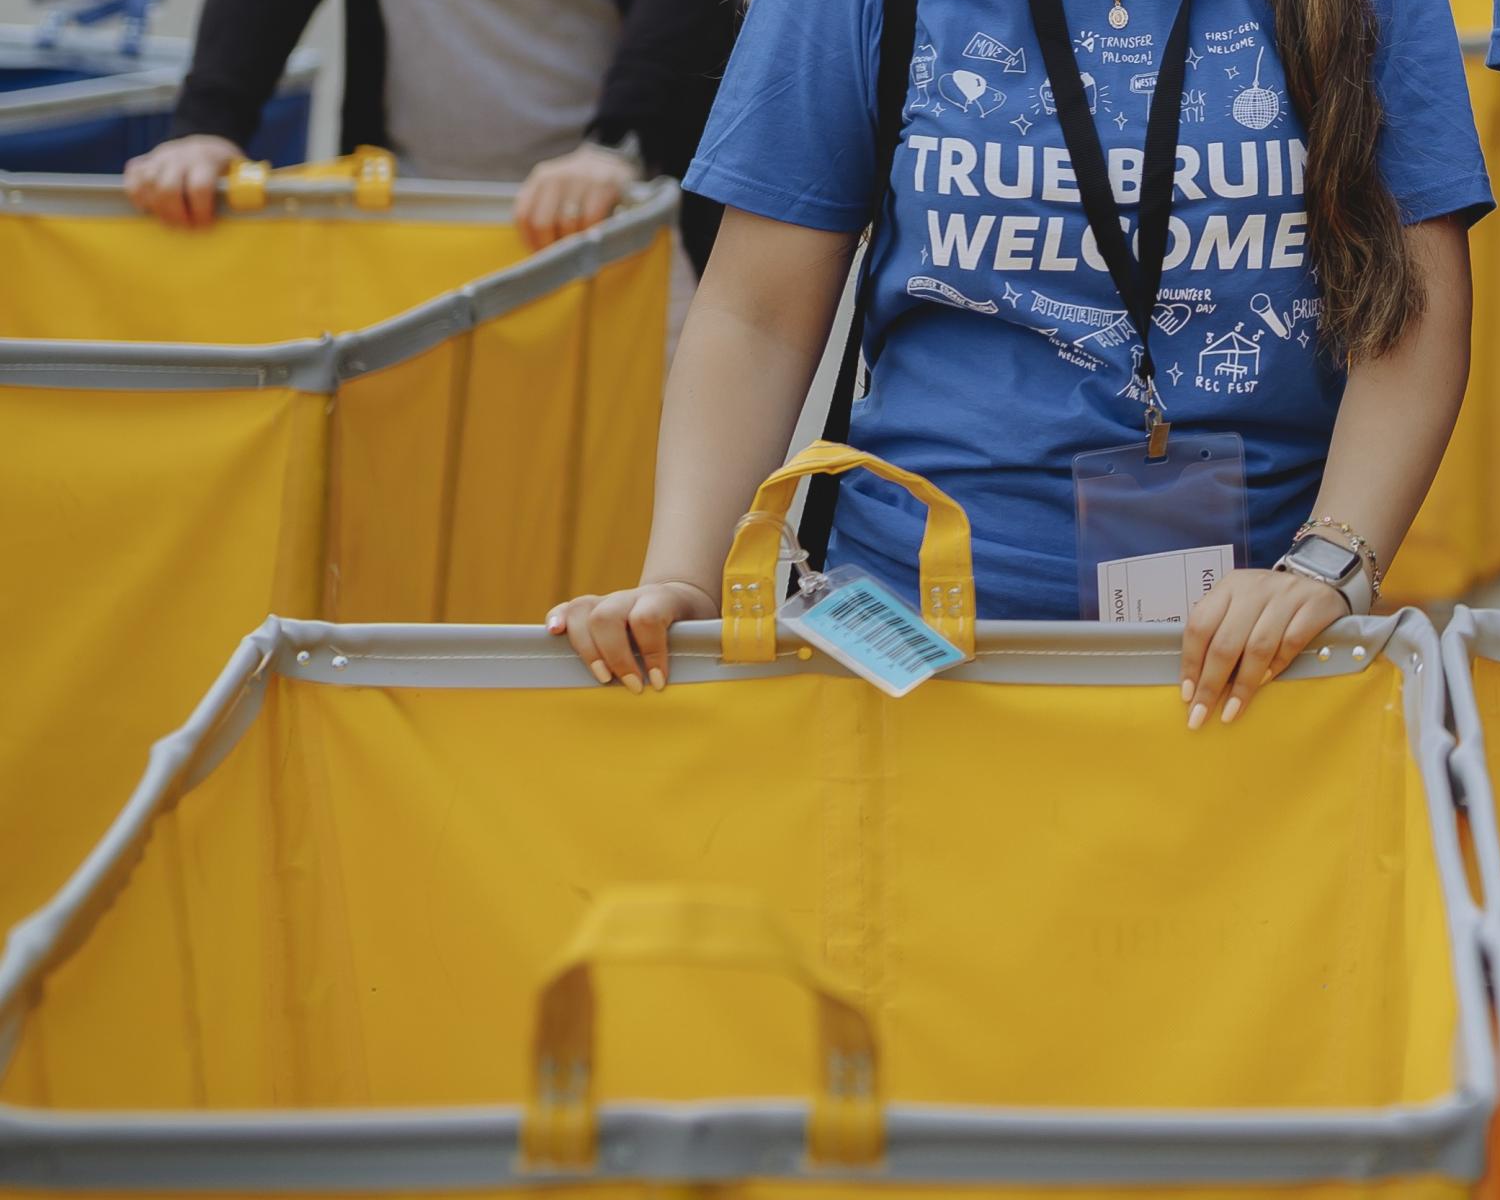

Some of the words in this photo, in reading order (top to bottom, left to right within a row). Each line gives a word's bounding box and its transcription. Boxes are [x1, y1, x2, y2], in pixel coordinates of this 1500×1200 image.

[1100, 34, 1154, 49] TRANSFER
[1204, 21, 1260, 42] FIRST-GEN
[968, 39, 1002, 59] MOVE
[1005, 54, 1020, 67] IN
[1207, 36, 1256, 55] WELCOME
[1102, 50, 1153, 66] PALOOZA!
[907, 134, 1083, 203] TRUE
[927, 210, 1308, 273] WELCOME
[1155, 287, 1213, 302] VOLUNTEER
[1195, 303, 1217, 314] DAY
[1057, 348, 1097, 372] WELCOME
[1195, 375, 1220, 392] REC
[1228, 381, 1259, 395] FEST
[1113, 588, 1125, 622] MOVE
